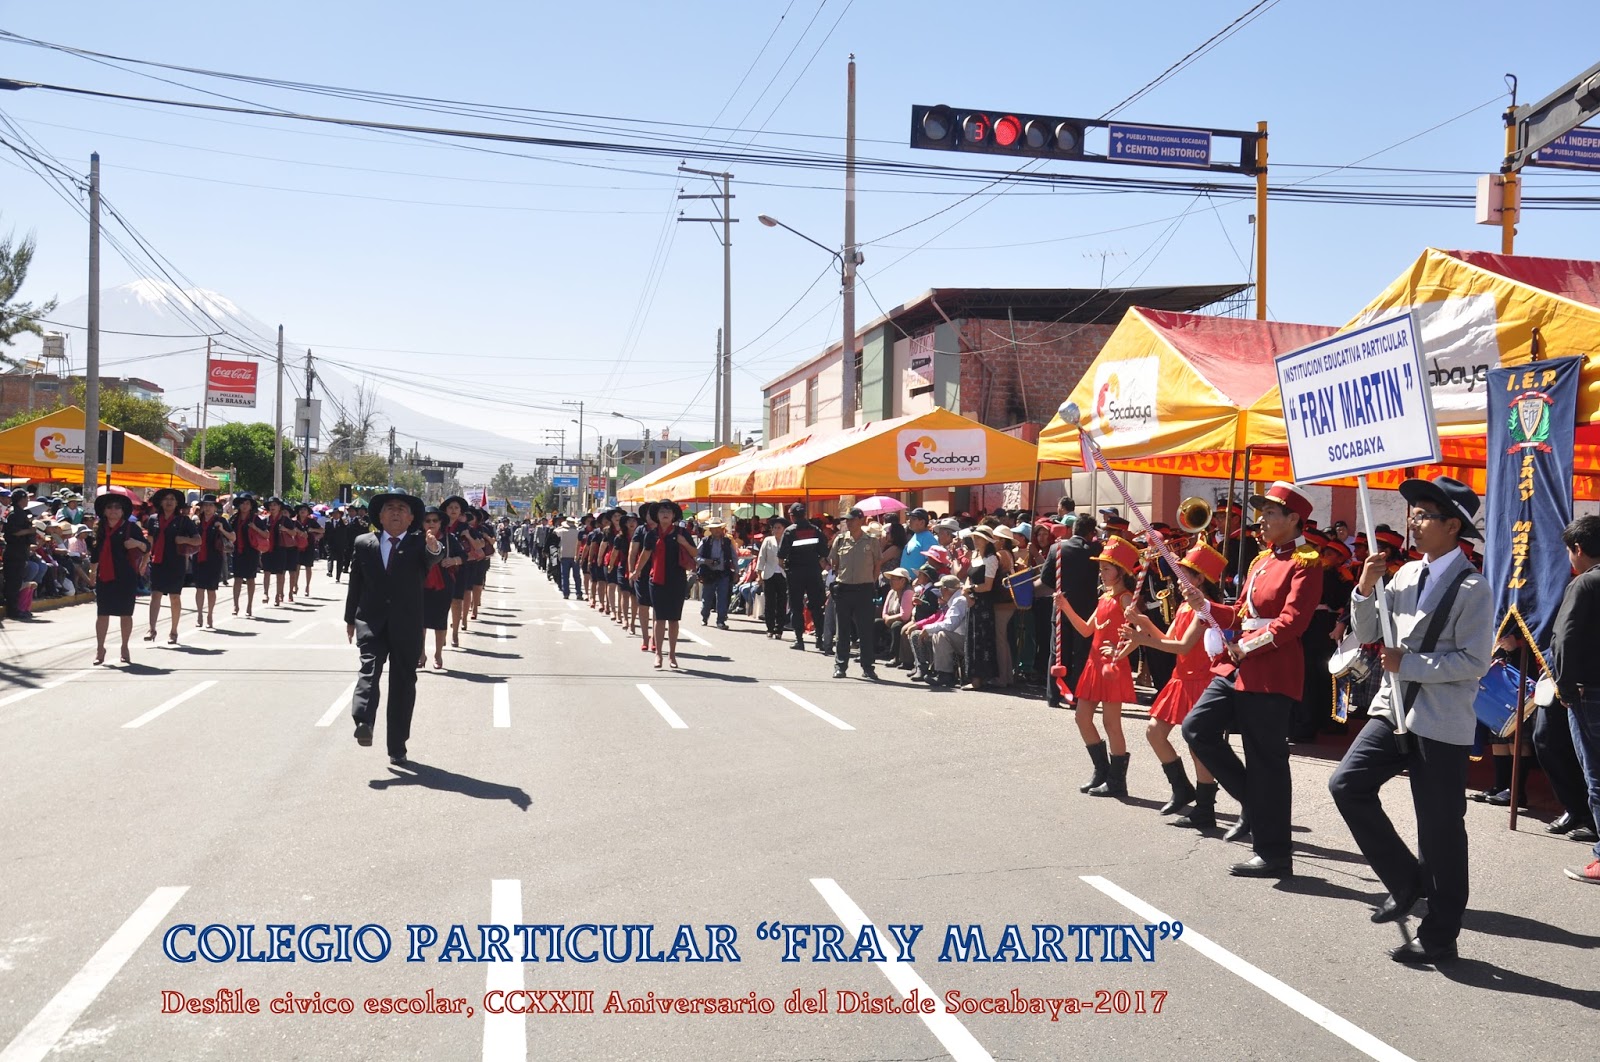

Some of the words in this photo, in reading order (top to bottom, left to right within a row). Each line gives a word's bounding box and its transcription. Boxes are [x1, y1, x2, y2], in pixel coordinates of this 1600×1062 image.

[1126, 133, 1146, 141] PUEBLO
[1147, 135, 1181, 144] TRADICIONAL
[1181, 137, 1208, 146] SOCABAYA
[1125, 144, 1159, 156] CENTRO
[1161, 147, 1207, 159] HISTORICO
[1554, 148, 1574, 157] PUEBLO
[1575, 150, 1600, 160] TRADICION
[1283, 359, 1324, 384] INSTITUCION
[1324, 345, 1362, 372] EDUCATIVA
[1362, 329, 1409, 358] PARTICULAR
[211, 366, 252, 380] Coca-Cola
[1427, 358, 1489, 392] abaya
[1109, 399, 1152, 424] Socabaya
[55, 444, 85, 454] Socab
[923, 451, 980, 466] Socabaya
[1328, 435, 1386, 462] SOCABAYA
[1518, 455, 1535, 502] FRAY
[1508, 521, 1532, 589] MARTIN
